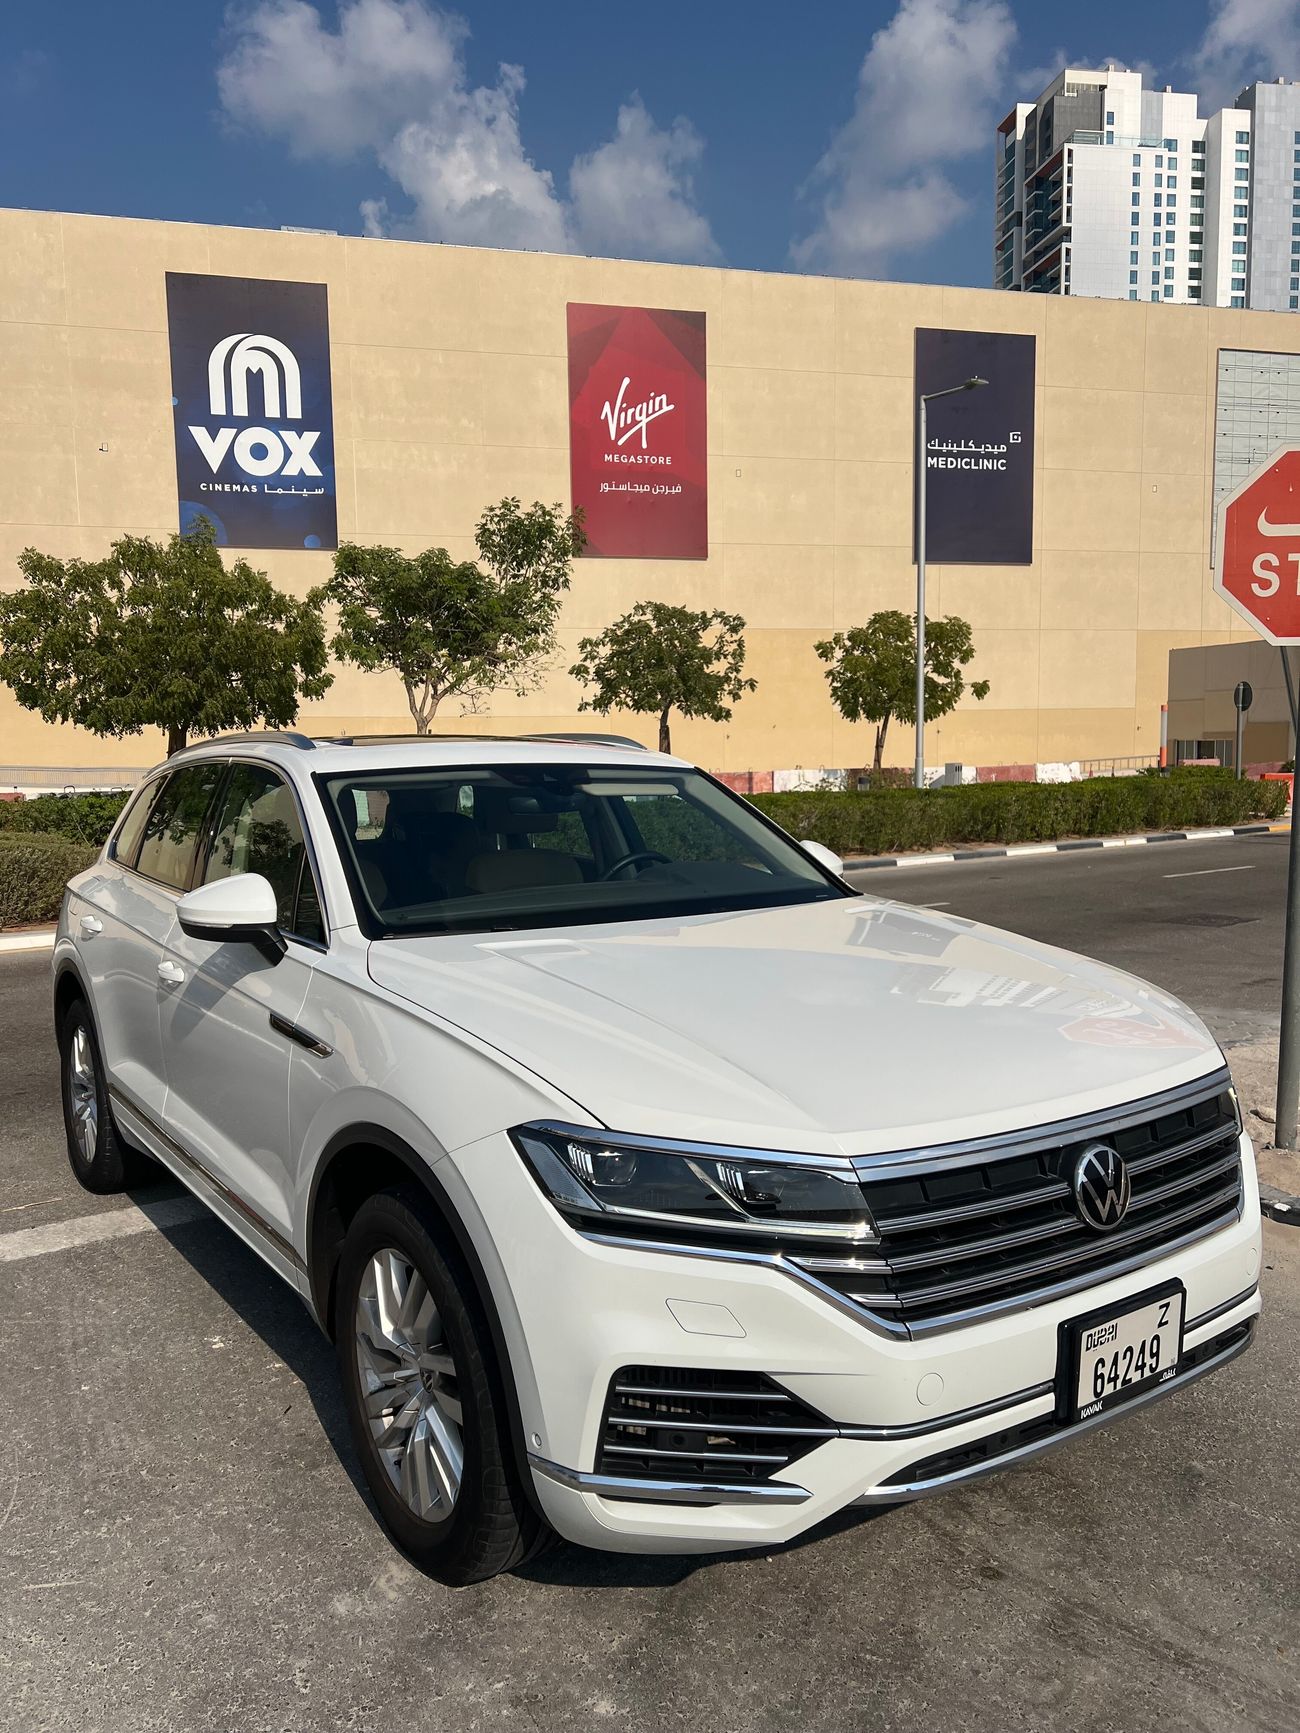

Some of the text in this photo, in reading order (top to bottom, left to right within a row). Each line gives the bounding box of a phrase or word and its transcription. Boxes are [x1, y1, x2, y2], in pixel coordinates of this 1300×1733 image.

[600, 376, 675, 449] Virgin
[187, 425, 324, 477] VOX
[604, 453, 672, 465] MEGASTORE
[927, 456, 1007, 470] MEDICLINIC
[200, 482, 258, 493] CINEMAS
[264, 483, 325, 497] سينما
[599, 480, 682, 495] فيرجن ميجاستور
[1157, 1301, 1171, 1329] Z
[1093, 1333, 1161, 1399] 64249
[1080, 1400, 1103, 1420] KAVAK
